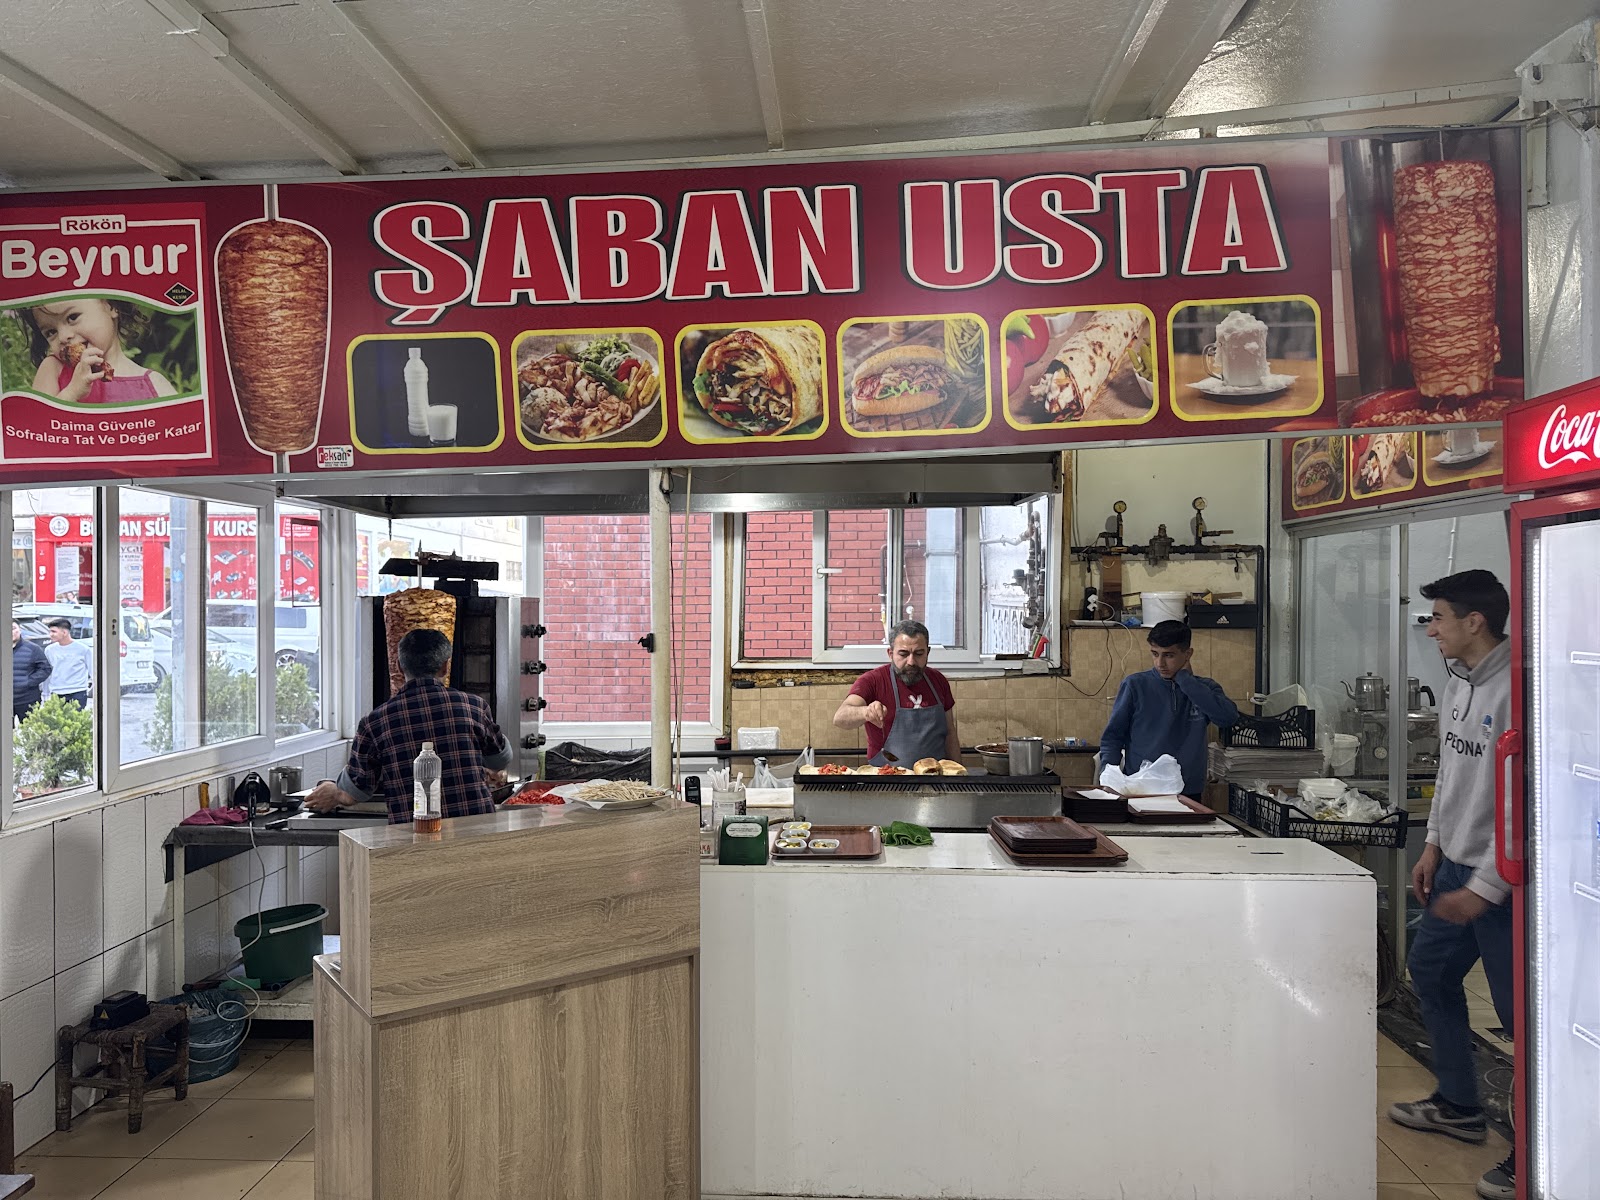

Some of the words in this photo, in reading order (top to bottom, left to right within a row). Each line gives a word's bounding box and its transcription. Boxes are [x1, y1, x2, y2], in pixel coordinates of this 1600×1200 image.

[65, 217, 123, 232] Rökön
[1, 238, 188, 287] Beynur
[371, 183, 861, 326] ŞABAN
[904, 165, 1288, 290] USTA
[5, 425, 70, 445] Sofralara
[73, 434, 95, 445] Tat
[99, 433, 116, 445] Ve
[119, 430, 161, 447] Değer
[164, 421, 202, 440] Katar
[50, 418, 95, 432] Daima
[98, 417, 156, 432] Güvenle
[1538, 403, 1600, 469] Coca
